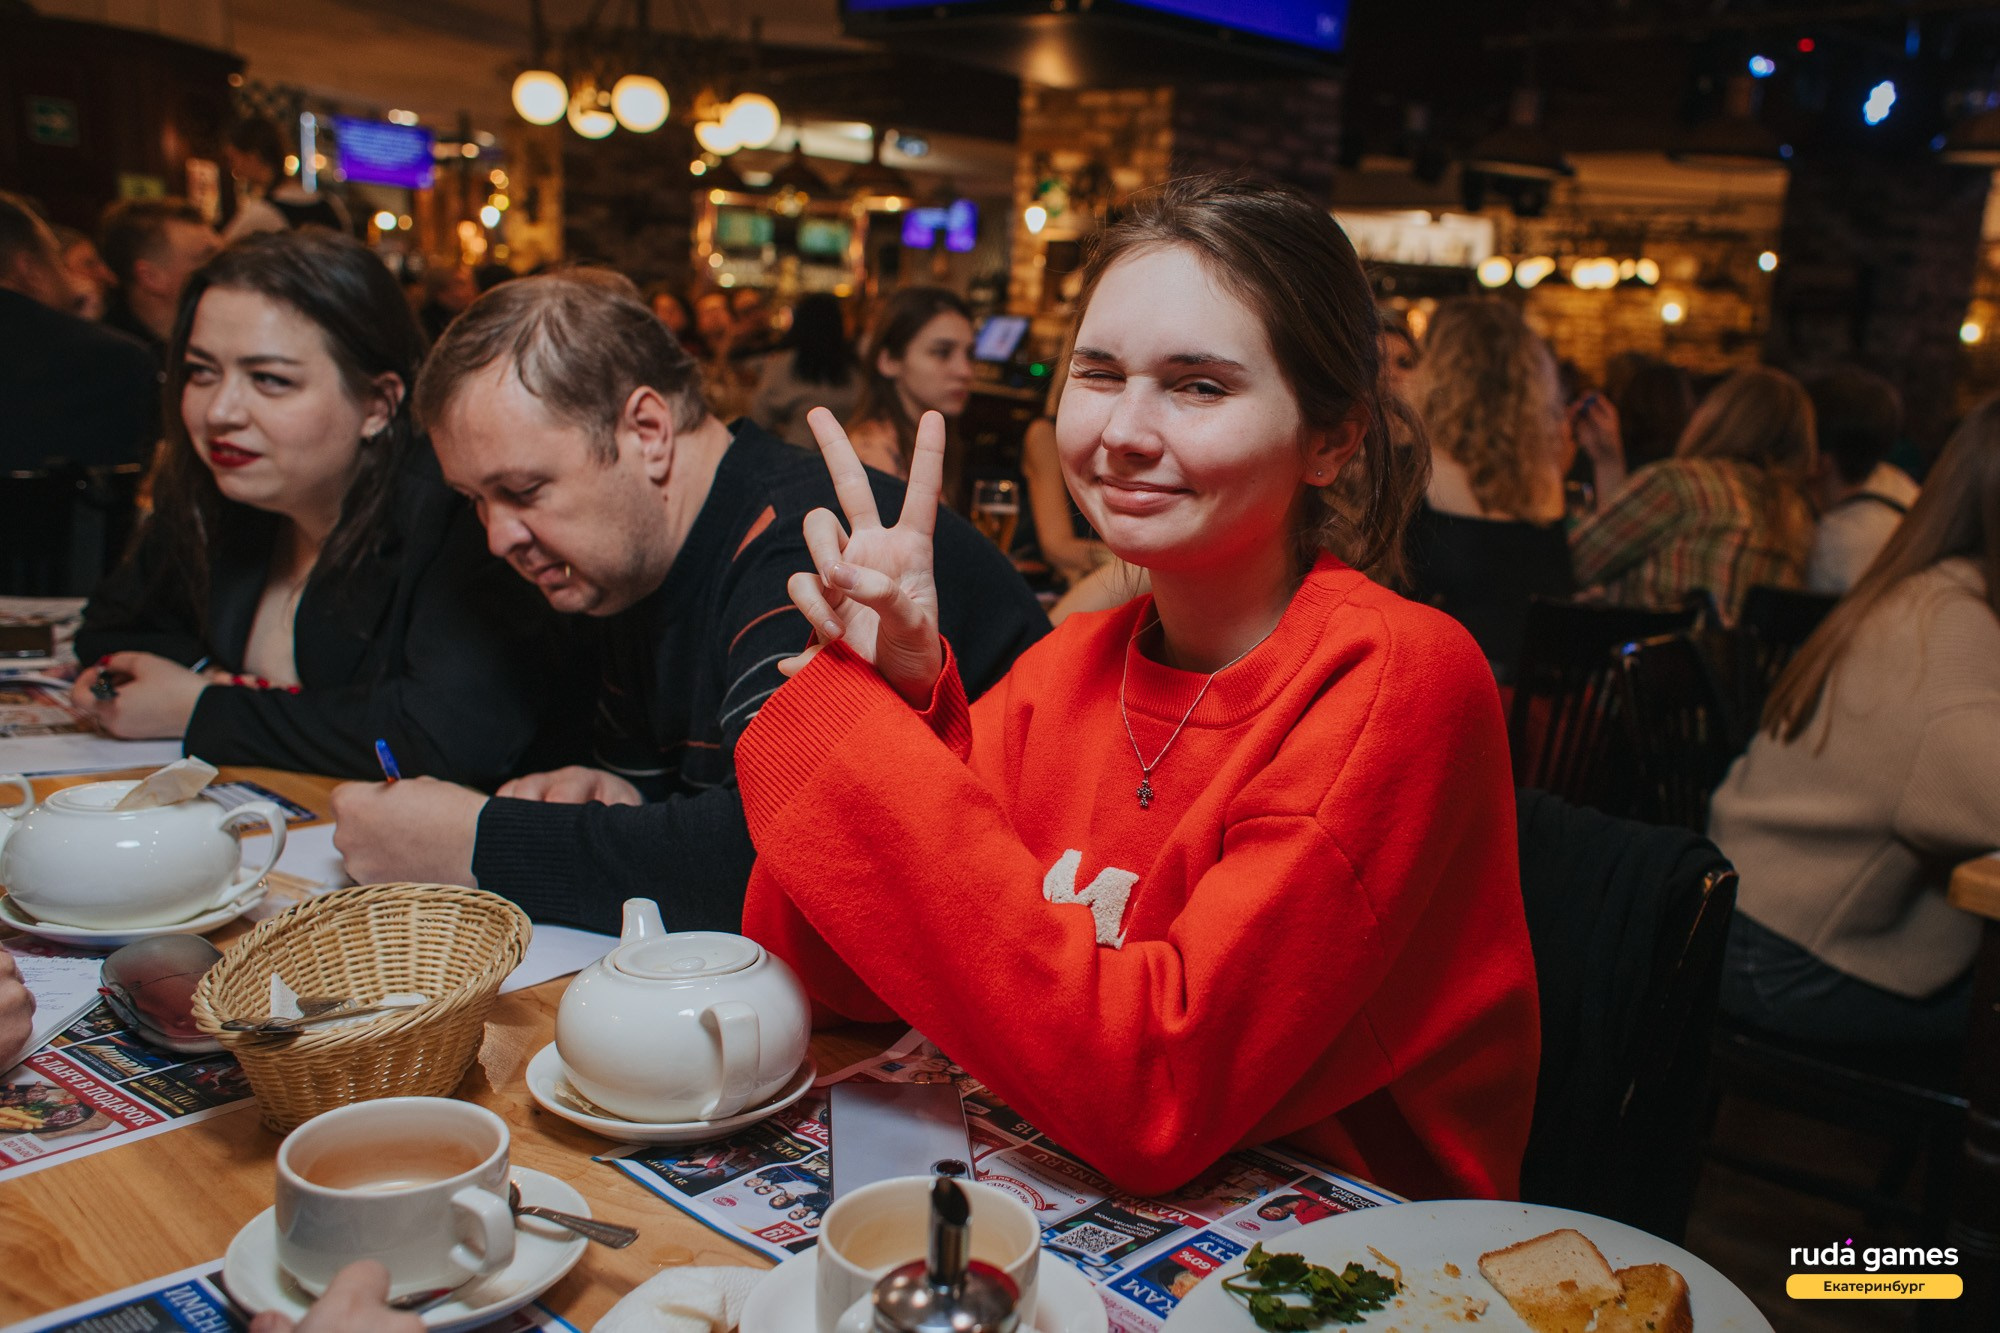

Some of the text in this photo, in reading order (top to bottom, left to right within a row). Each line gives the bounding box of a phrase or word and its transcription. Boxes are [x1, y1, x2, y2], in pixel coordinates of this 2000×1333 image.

[43, 1060, 87, 1084] ЛАНЧ
[73, 1080, 95, 1089] В
[82, 1086, 156, 1126] ПОДАРОК
[1011, 1123, 1033, 1135] 15
[1331, 1192, 1365, 1210] ОЖЬЯ
[1332, 1185, 1378, 1208] ОРОВКА
[761, 1228, 791, 1241] 19
[1179, 1250, 1211, 1270] 60%
[1193, 1241, 1238, 1261] СТУ
[1120, 1278, 1174, 1314] КАМ
